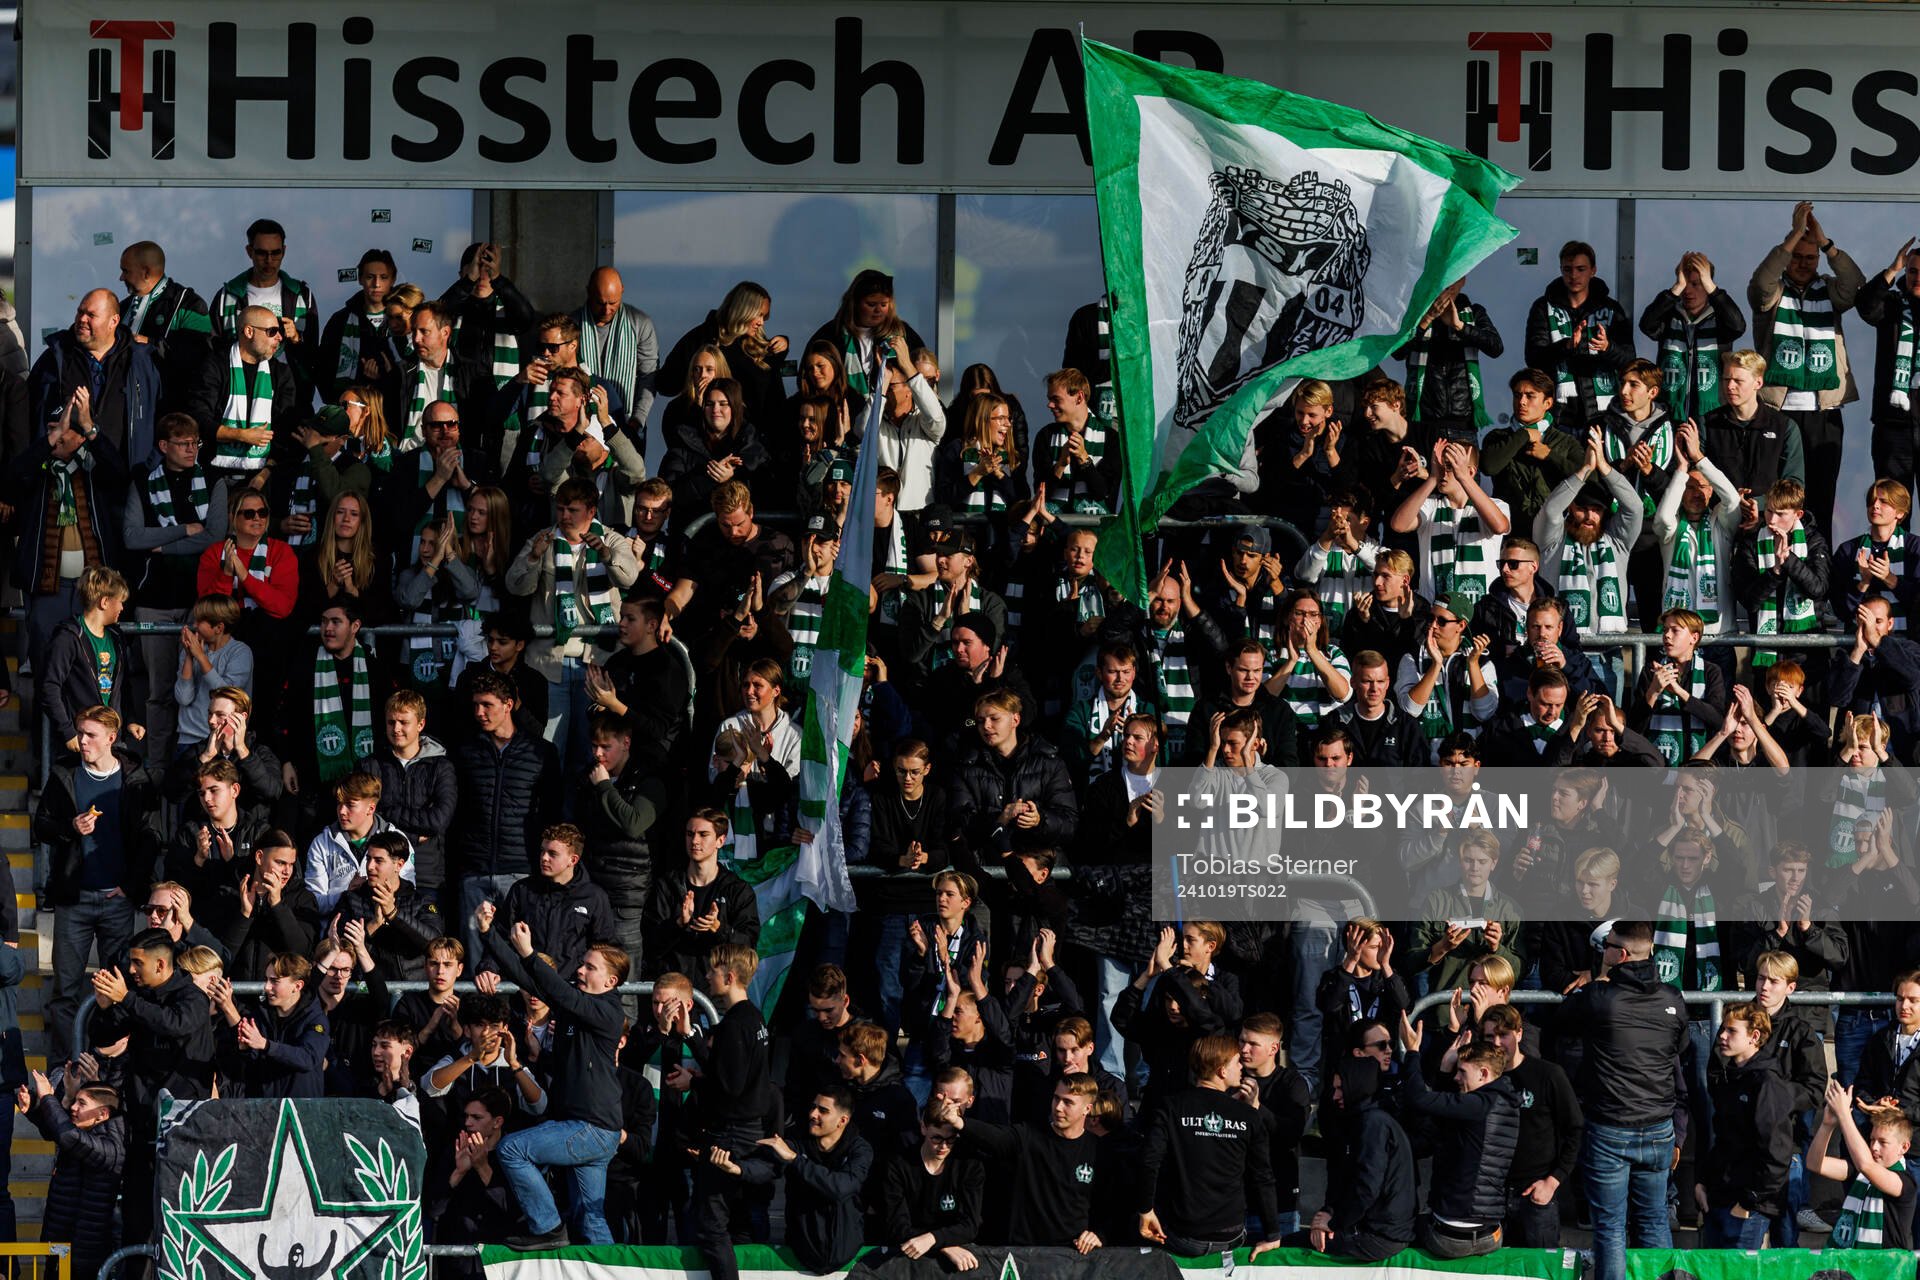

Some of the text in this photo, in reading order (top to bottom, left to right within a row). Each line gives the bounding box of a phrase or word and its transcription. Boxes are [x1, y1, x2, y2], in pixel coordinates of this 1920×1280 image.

[207, 16, 926, 165] Hisstech
[1582, 27, 1920, 175] Hiss
[1314, 286, 1345, 318] 04
